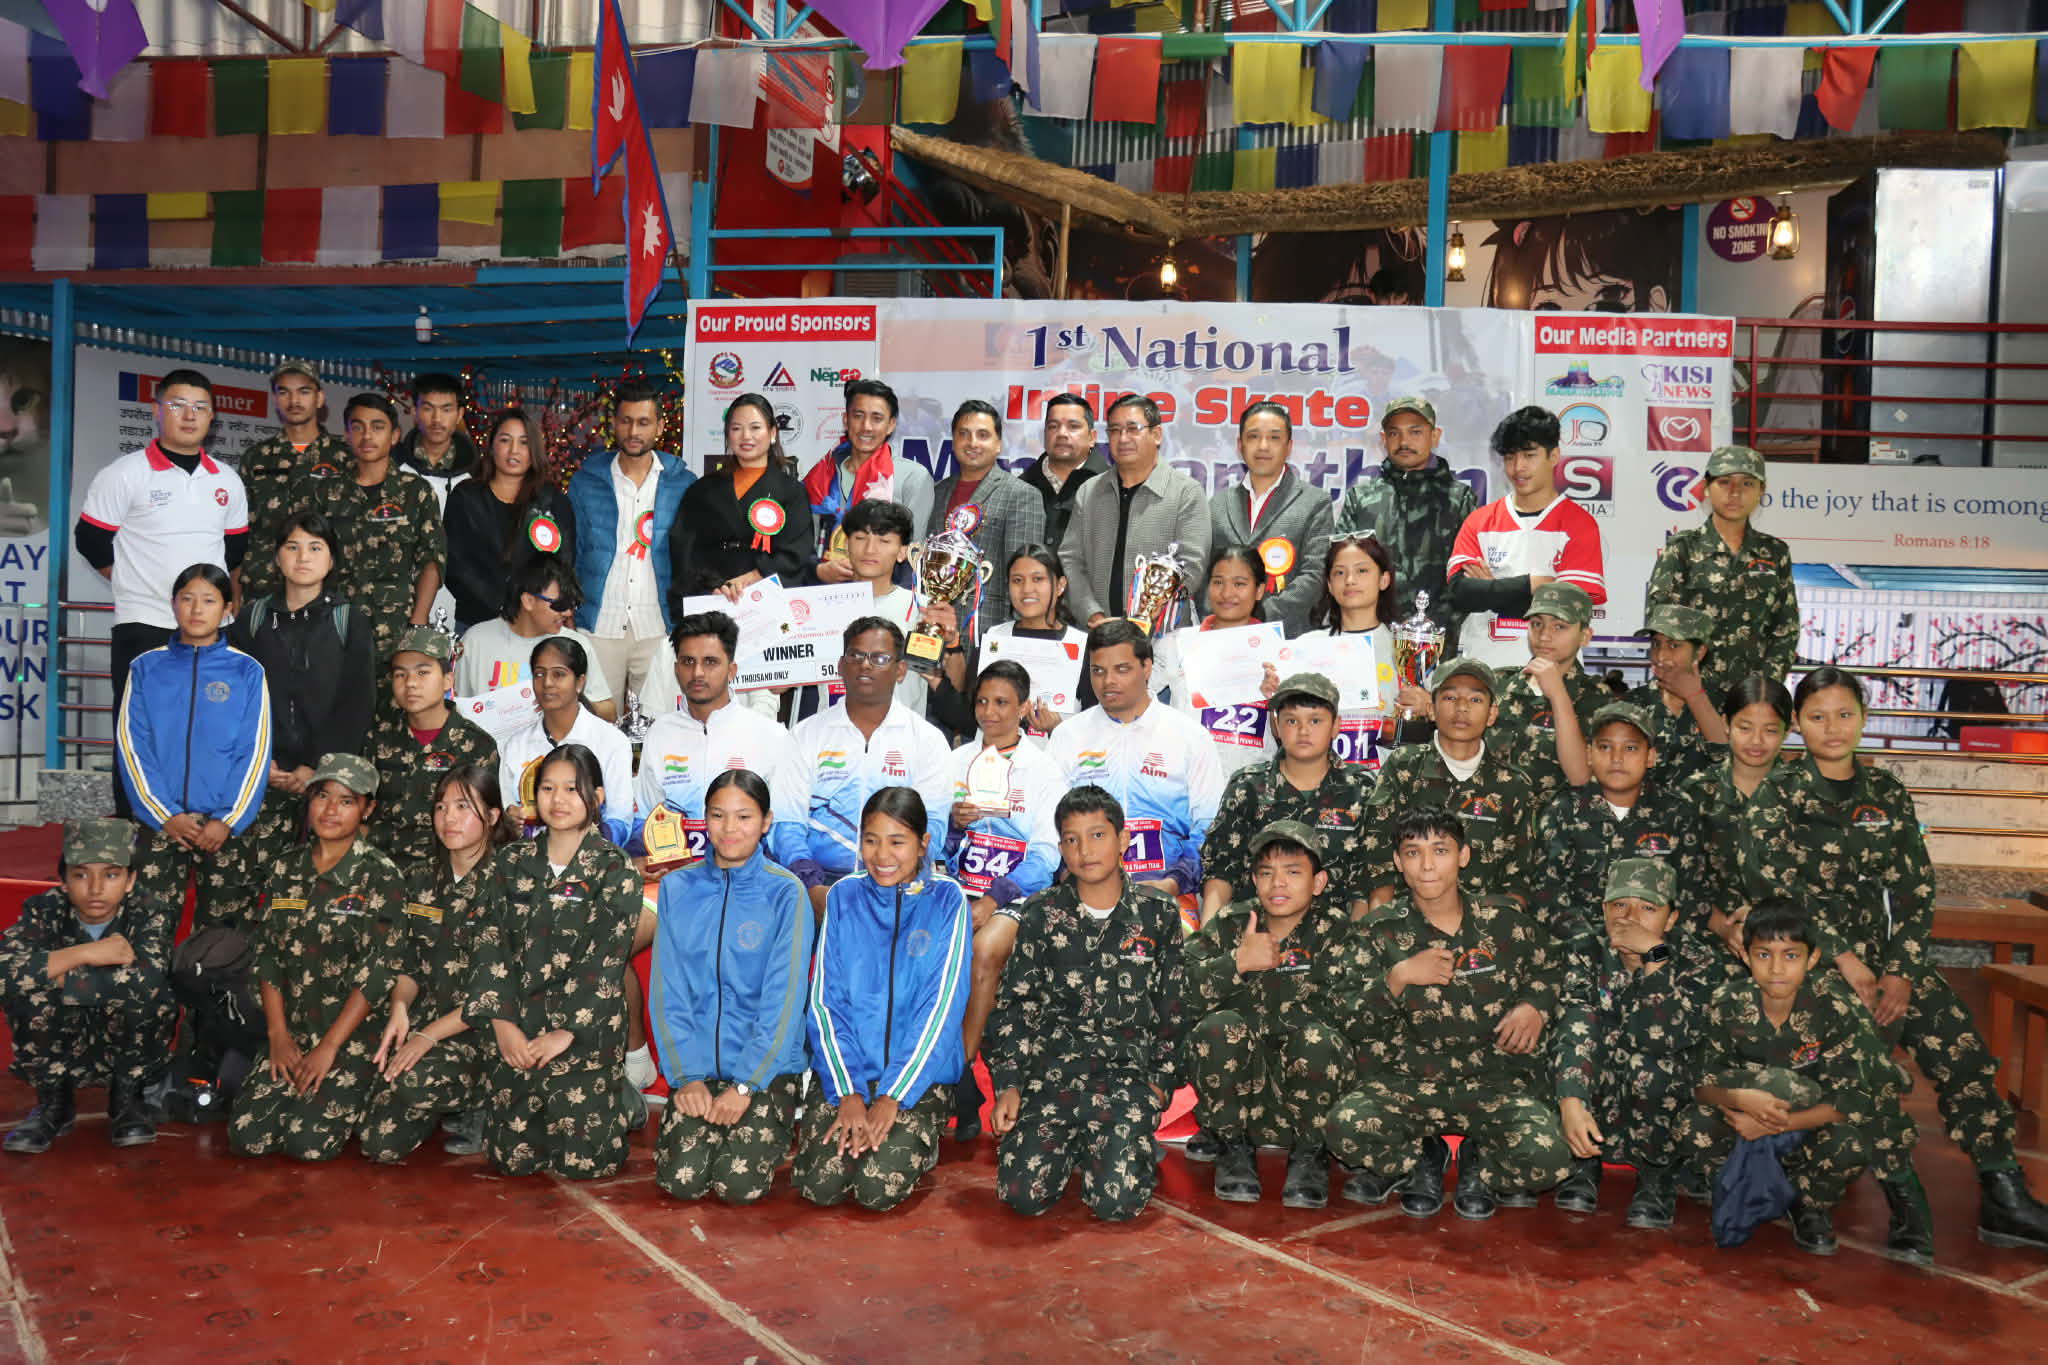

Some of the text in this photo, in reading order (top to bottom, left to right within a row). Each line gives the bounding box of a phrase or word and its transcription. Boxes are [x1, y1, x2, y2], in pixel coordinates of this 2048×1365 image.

[1712, 223, 1770, 240] NO SMOKIN
[1731, 240, 1757, 255] ZONE
[700, 313, 871, 333] Our Proud Sponsors
[1539, 326, 1728, 349] Our Media Partners
[1026, 323, 1356, 373] 1st National
[1663, 365, 1713, 384] KISI
[1663, 385, 1712, 399] NEWS
[1006, 384, 1177, 421] Inie
[1782, 487, 1819, 509] the
[1824, 489, 1864, 518] joy
[1872, 489, 1919, 512] that
[1926, 492, 1946, 512] is
[1953, 498, 2048, 524] comong
[1894, 533, 1991, 549] Romans 8:18
[0, 618, 48, 646] UR
[763, 643, 815, 662] WINNER
[741, 671, 773, 684] THOUSAND
[774, 670, 789, 681] ONLY
[1212, 705, 1259, 735] 22
[881, 765, 906, 777] Aim
[1140, 765, 1168, 779] Aim
[1009, 803, 1026, 813] im
[688, 831, 709, 857] 2
[964, 846, 1010, 874] 54
